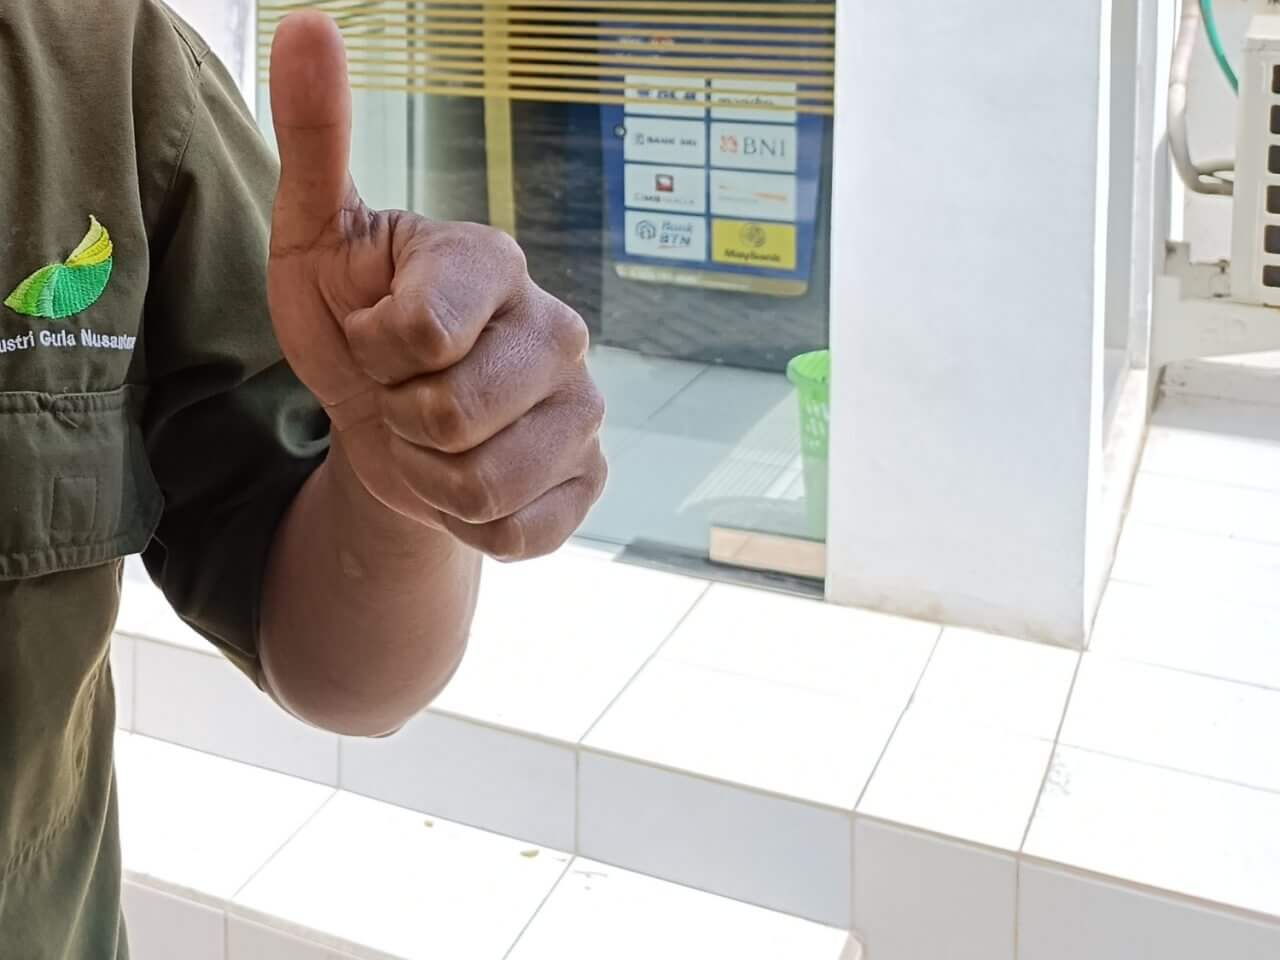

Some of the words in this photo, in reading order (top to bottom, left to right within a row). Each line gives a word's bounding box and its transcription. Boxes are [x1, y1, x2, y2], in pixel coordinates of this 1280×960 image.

[743, 136, 786, 158] BNI
[659, 234, 692, 246] BTN
[724, 249, 781, 262] Maybank
[39, 329, 76, 347] Gula
